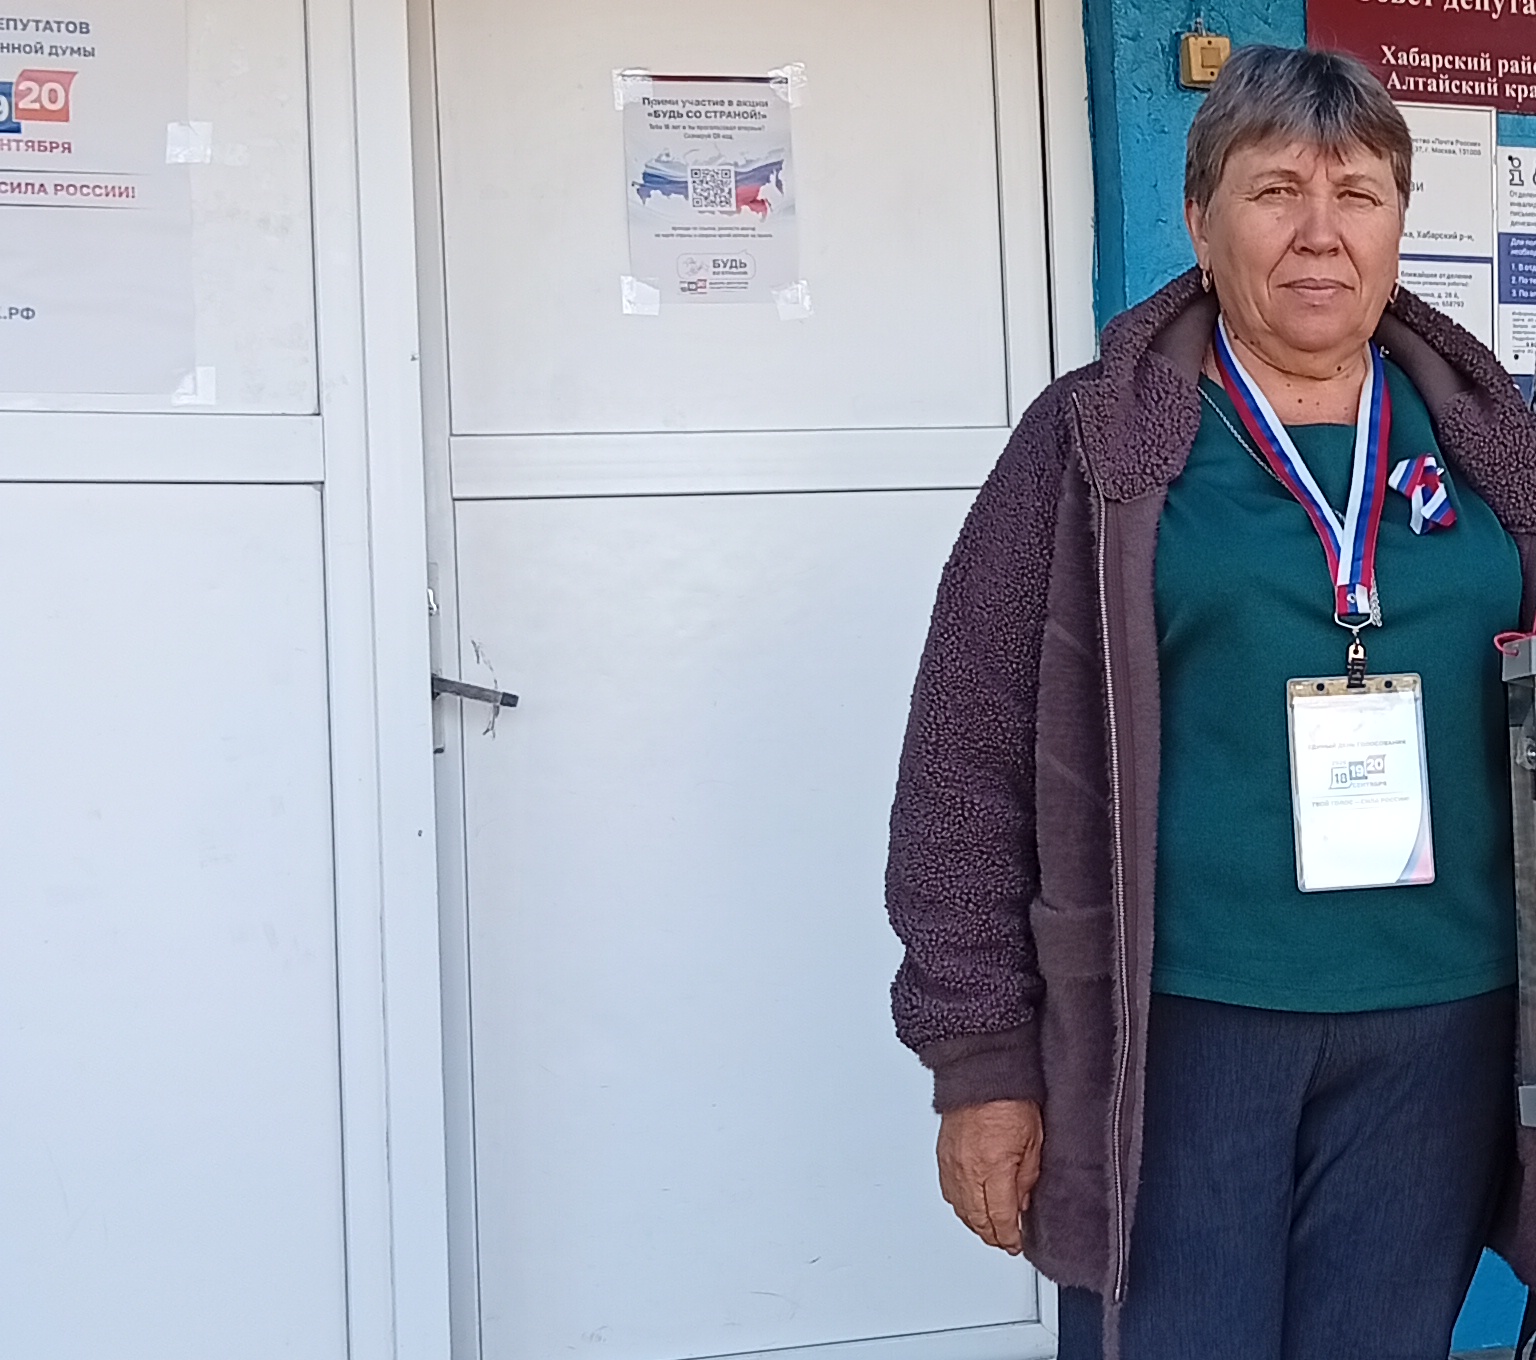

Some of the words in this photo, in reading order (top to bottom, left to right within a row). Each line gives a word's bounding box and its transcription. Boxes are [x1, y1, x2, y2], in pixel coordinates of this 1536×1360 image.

[49, 44, 96, 58] ДУМЫ
[1381, 45, 1492, 72] Хабарский
[1387, 71, 1498, 97] Алтайский
[18, 80, 66, 111] 20
[681, 98, 725, 108] участие
[736, 99, 768, 108] акции
[686, 110, 702, 119] СО
[0, 181, 48, 195] СИЛА
[54, 183, 136, 199] РОССИИ!
[712, 258, 747, 270] БУДЬ
[0, 307, 36, 320] .РФ
[1334, 772, 1348, 784] 18
[1350, 765, 1364, 778] 19
[1366, 758, 1384, 771] 20
